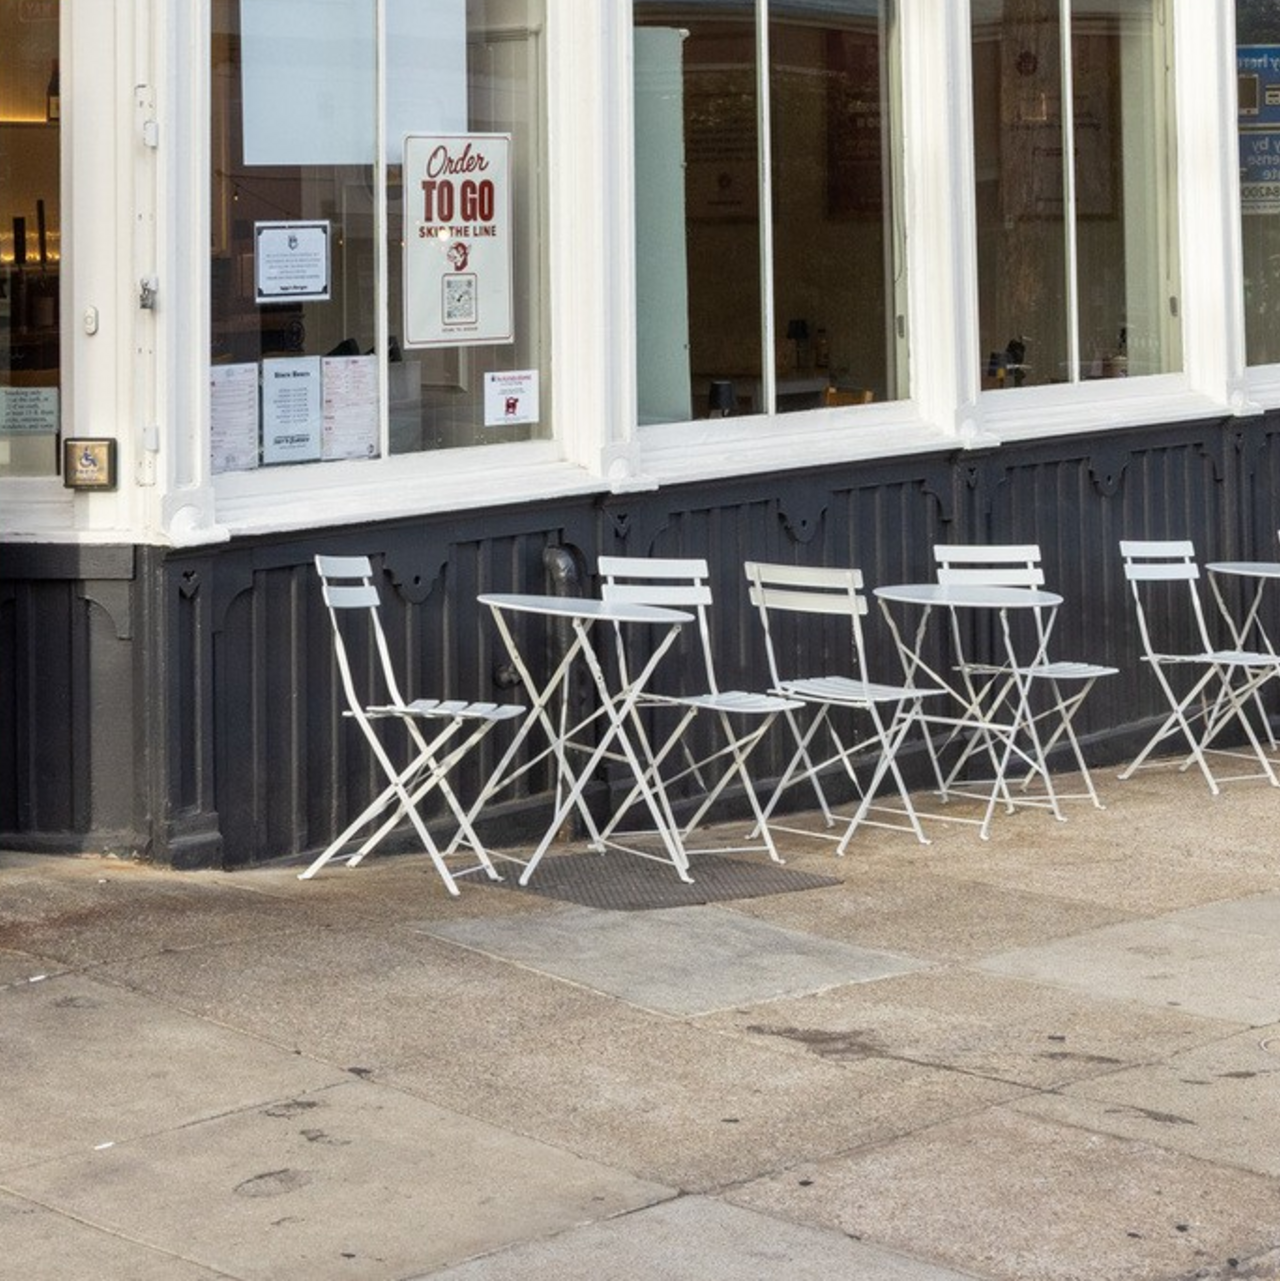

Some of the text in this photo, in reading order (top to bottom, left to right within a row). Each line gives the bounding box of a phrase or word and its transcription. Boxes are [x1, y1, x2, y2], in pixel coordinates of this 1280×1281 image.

[426, 142, 489, 178] Order
[422, 178, 495, 223] TO GO
[449, 225, 470, 238] THE
[473, 224, 497, 237] LINE
